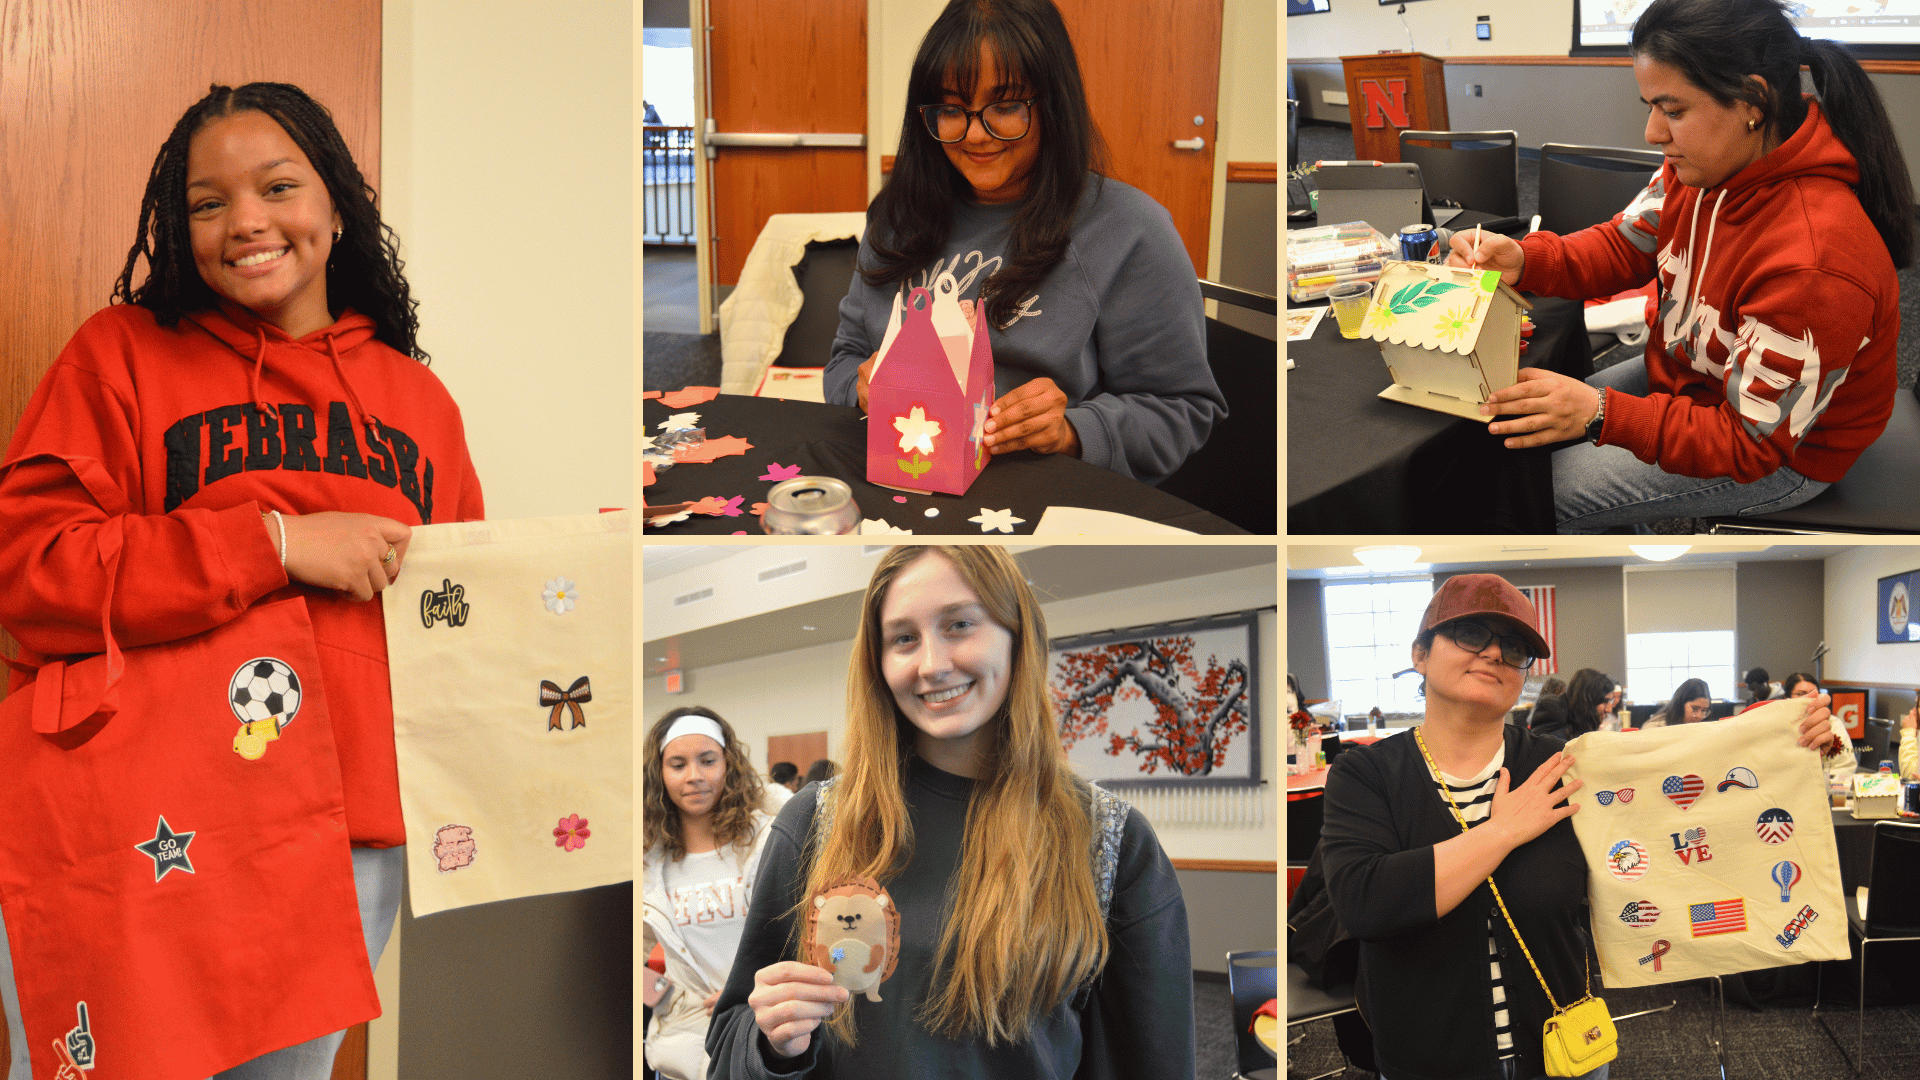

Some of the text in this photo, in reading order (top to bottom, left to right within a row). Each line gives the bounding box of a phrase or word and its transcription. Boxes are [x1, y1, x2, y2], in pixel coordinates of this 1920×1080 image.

[1360, 79, 1410, 129] N
[422, 579, 469, 627] faith
[1837, 704, 1859, 730] G
[156, 847, 183, 862] TEAM!
[158, 838, 177, 851] GO
[1775, 904, 1819, 949] LOVE
[77, 1045, 90, 1061] #1
